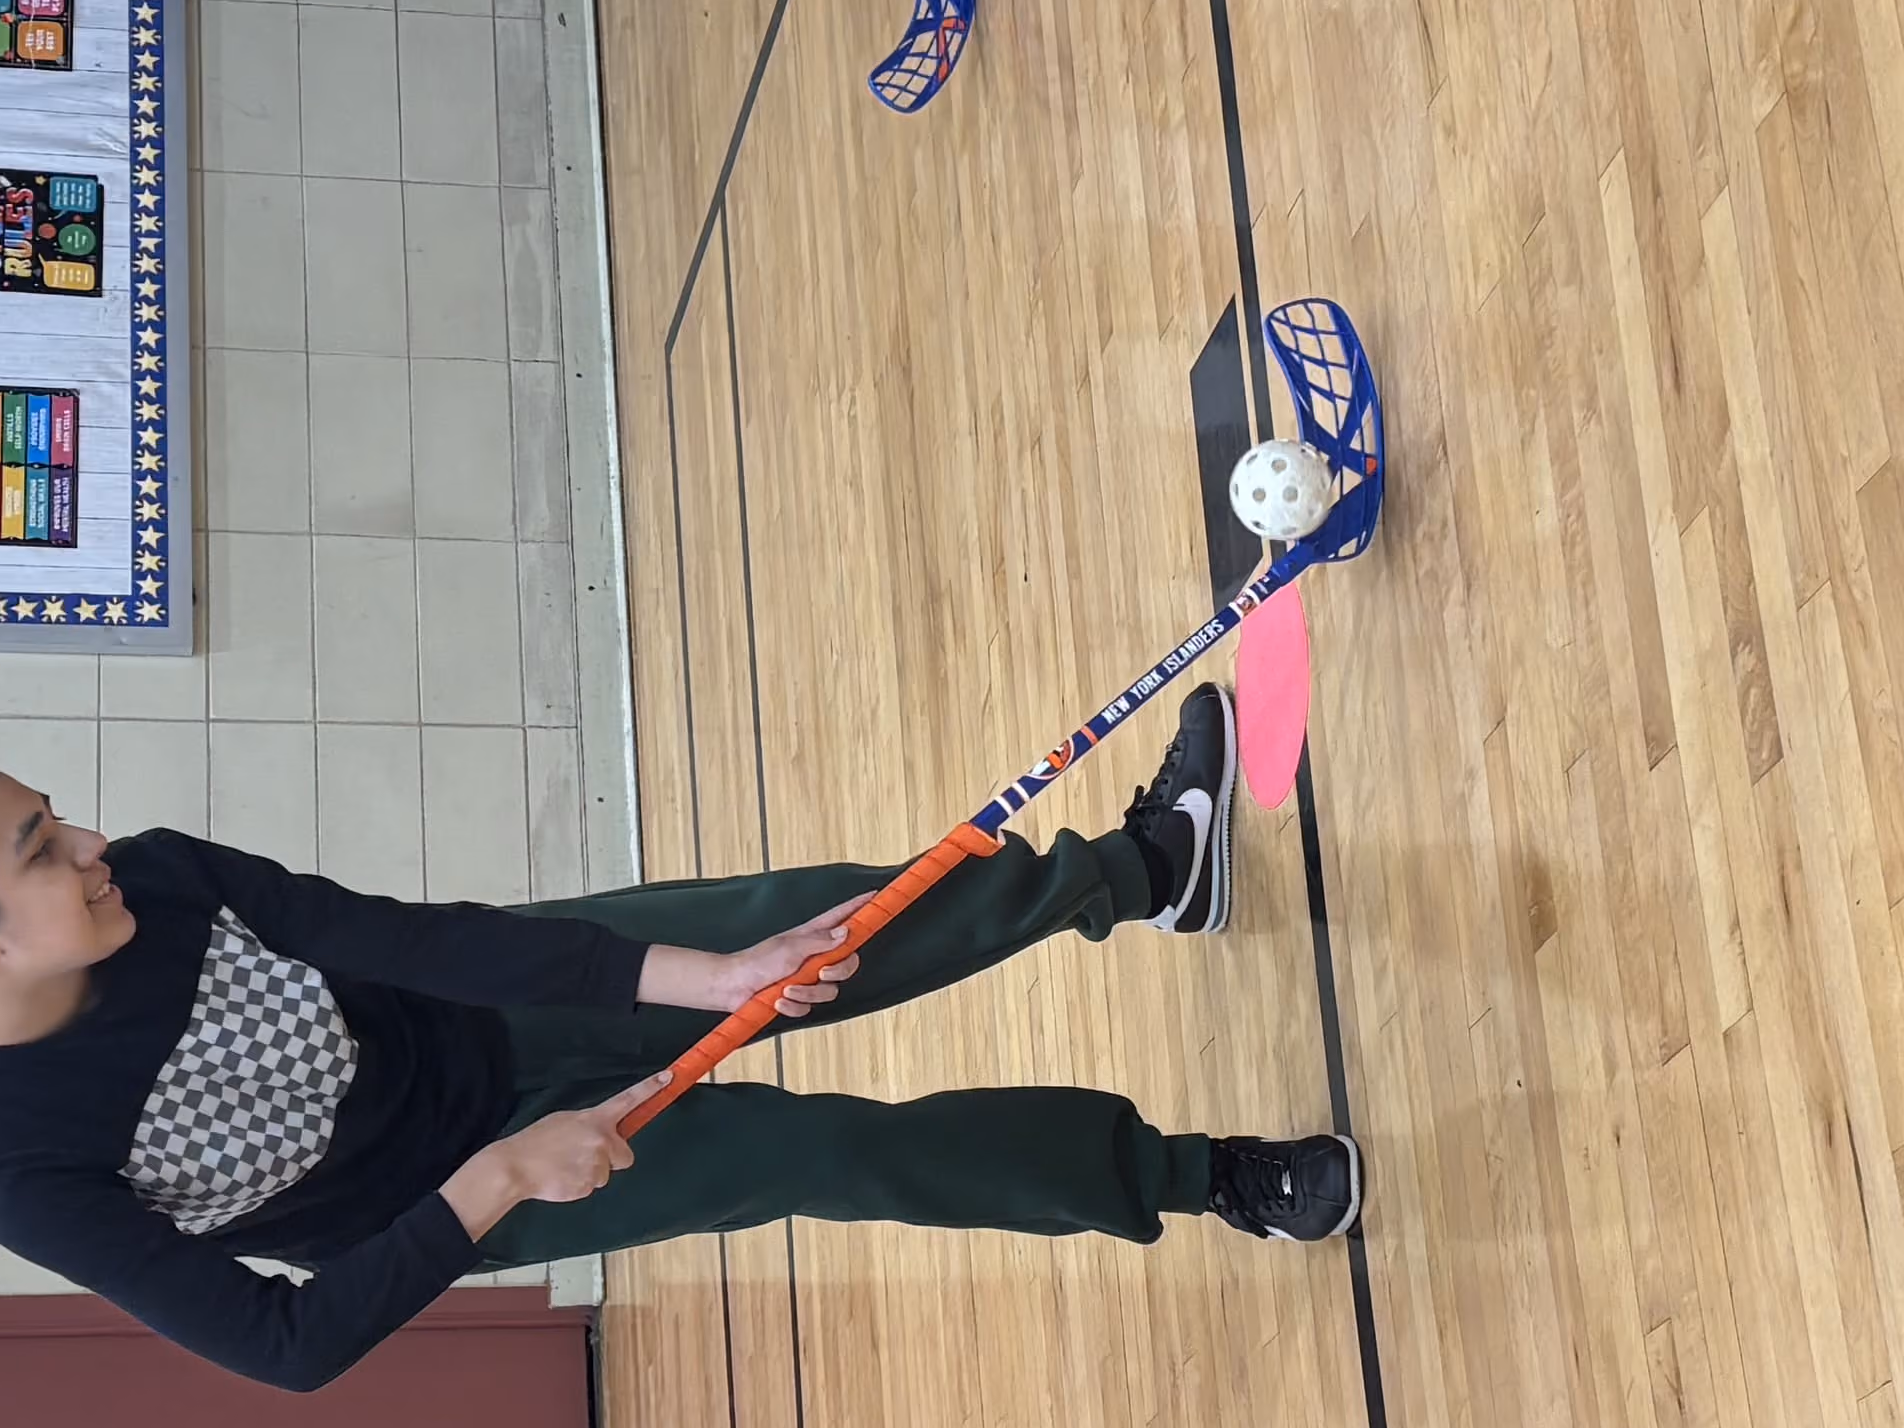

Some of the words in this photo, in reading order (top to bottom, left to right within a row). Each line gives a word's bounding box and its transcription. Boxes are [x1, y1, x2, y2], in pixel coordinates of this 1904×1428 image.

[4, 187, 33, 277] RULES
[1100, 697, 1132, 724] NEW
[1129, 671, 1164, 698] YORK
[1162, 618, 1225, 675] ISLANDERS
